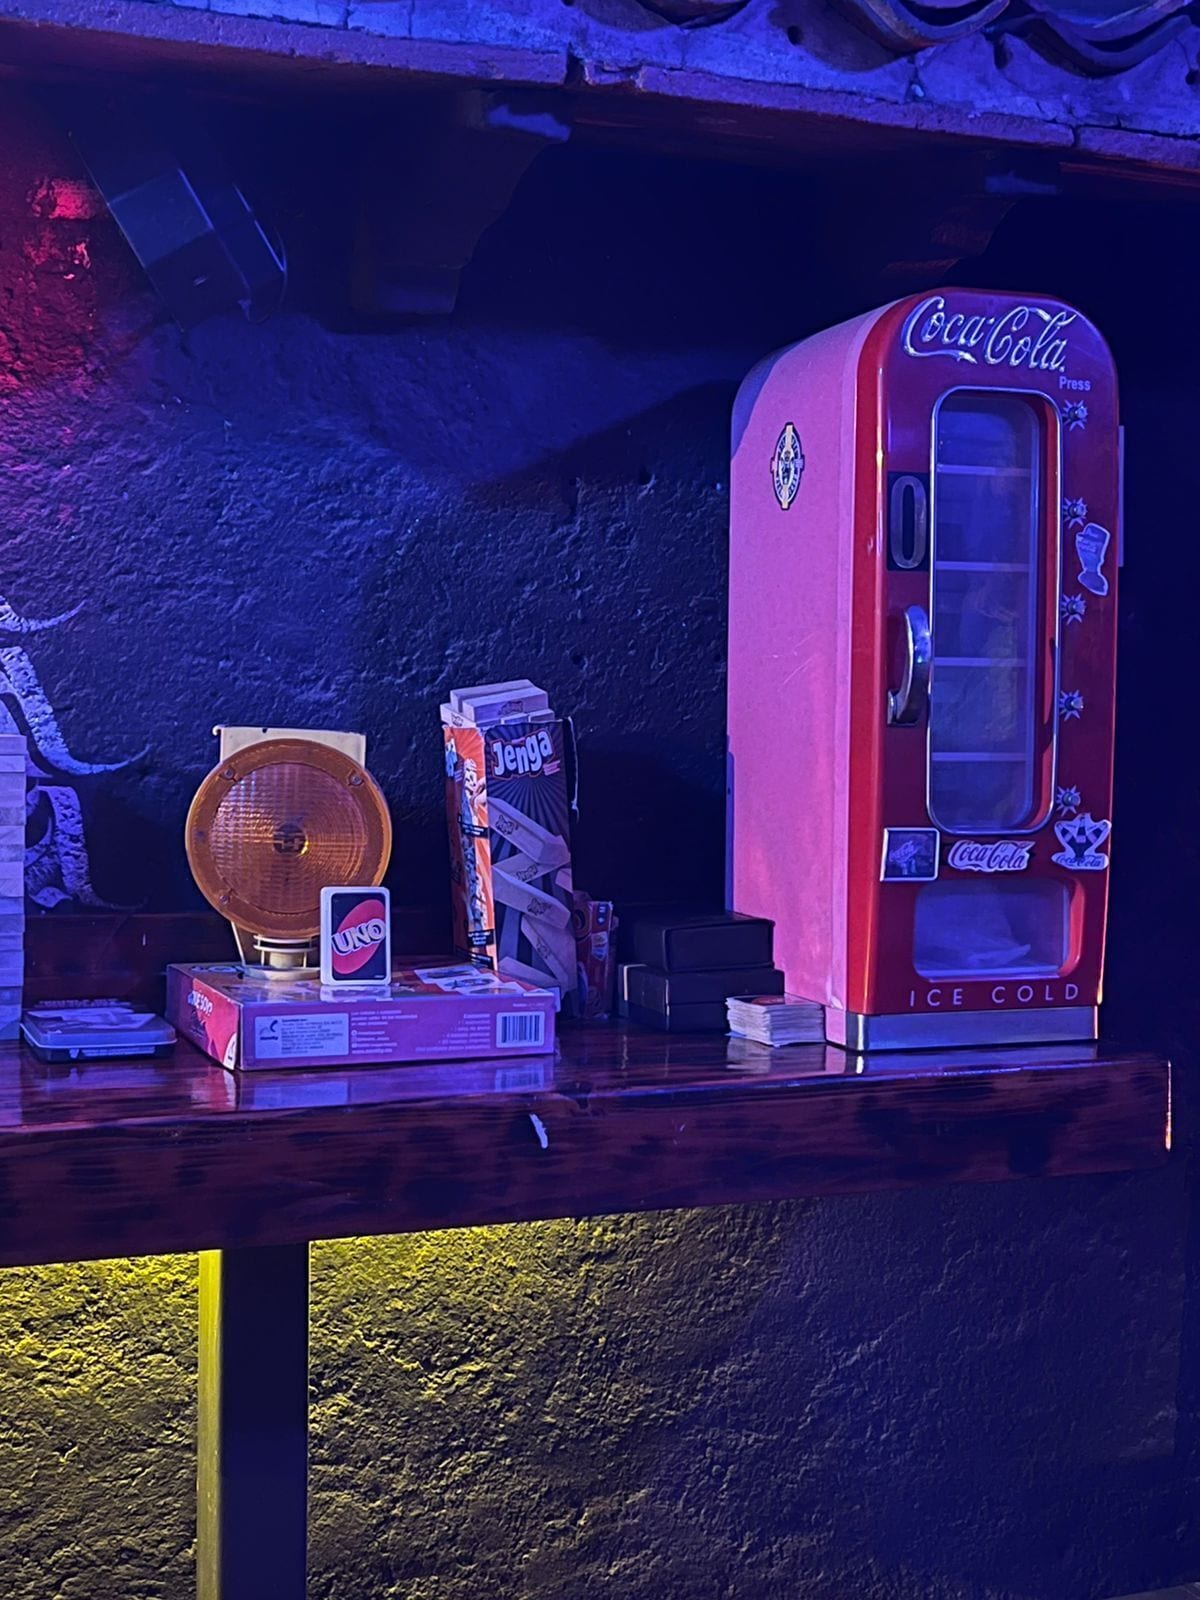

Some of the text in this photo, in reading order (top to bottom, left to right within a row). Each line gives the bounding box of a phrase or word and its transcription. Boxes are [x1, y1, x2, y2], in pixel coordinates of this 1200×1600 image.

[1059, 375, 1091, 391] Press
[492, 731, 553, 776] Jenga
[332, 918, 386, 956] UNO
[909, 984, 1079, 1007] ICE COLD
